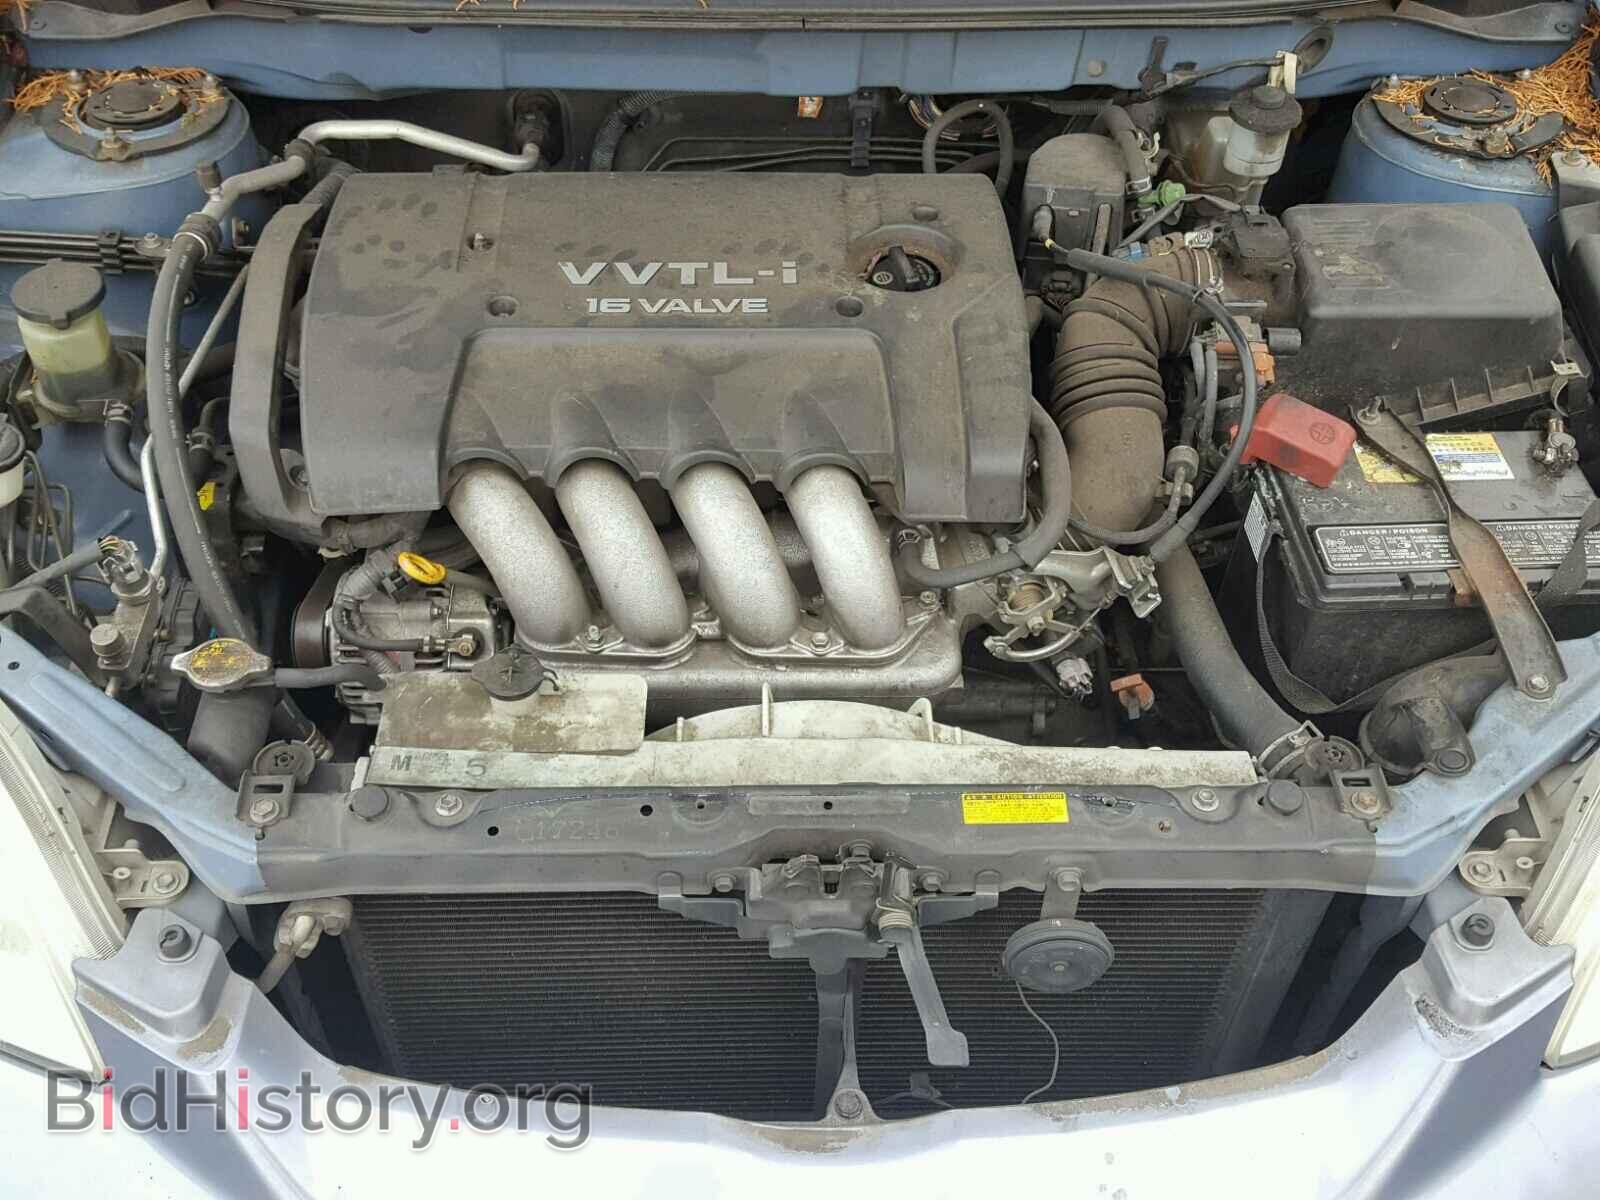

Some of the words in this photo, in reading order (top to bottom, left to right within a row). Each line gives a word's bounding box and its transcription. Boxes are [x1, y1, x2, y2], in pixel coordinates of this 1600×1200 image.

[557, 260, 799, 286] VVTL-i
[586, 297, 632, 314] 16
[637, 297, 769, 314] VALVE
